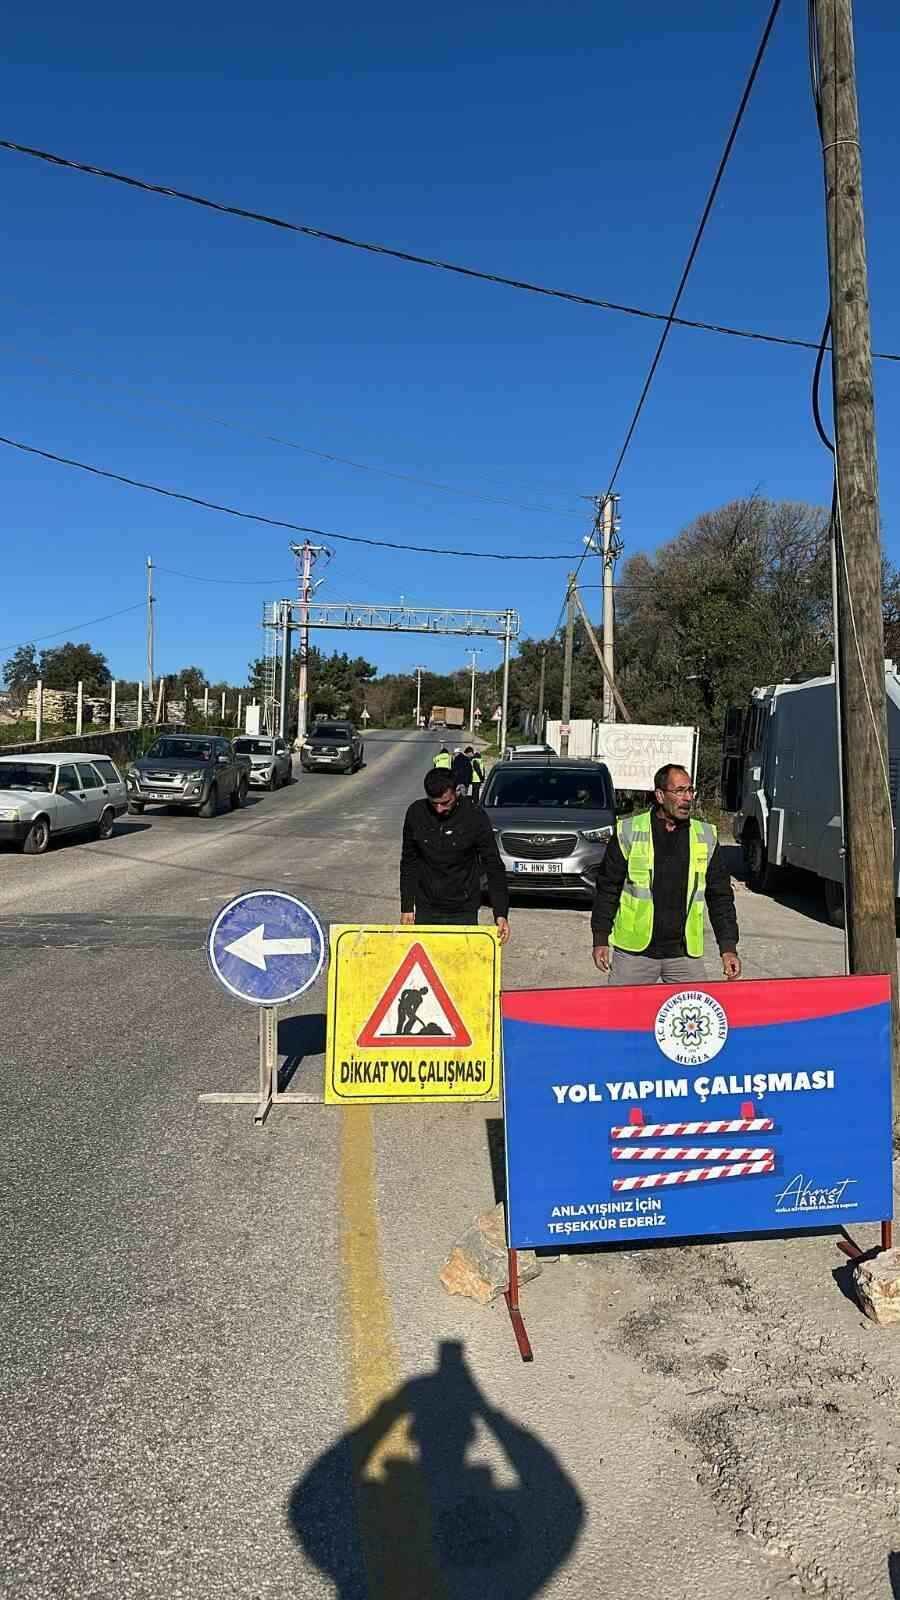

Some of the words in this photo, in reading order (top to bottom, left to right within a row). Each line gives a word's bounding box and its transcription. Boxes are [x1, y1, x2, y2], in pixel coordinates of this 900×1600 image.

[675, 1053, 710, 1064] MUĞLA
[340, 1055, 389, 1083] DİKKAT
[391, 1061, 416, 1083] YOL
[418, 1060, 486, 1089] ÇALIŞMASI
[552, 1083, 602, 1104] YOL
[606, 1079, 689, 1100] YAPIM
[693, 1070, 836, 1103] ÇALIŞMASI
[776, 1173, 857, 1207] Ahmet
[800, 1194, 835, 1207] ARAS
[551, 1200, 634, 1217] ANLAYIŞINIZ
[636, 1197, 661, 1213] İÇİN
[547, 1217, 616, 1235] TEŞEKKÜR
[619, 1213, 666, 1229] EDERİZ
